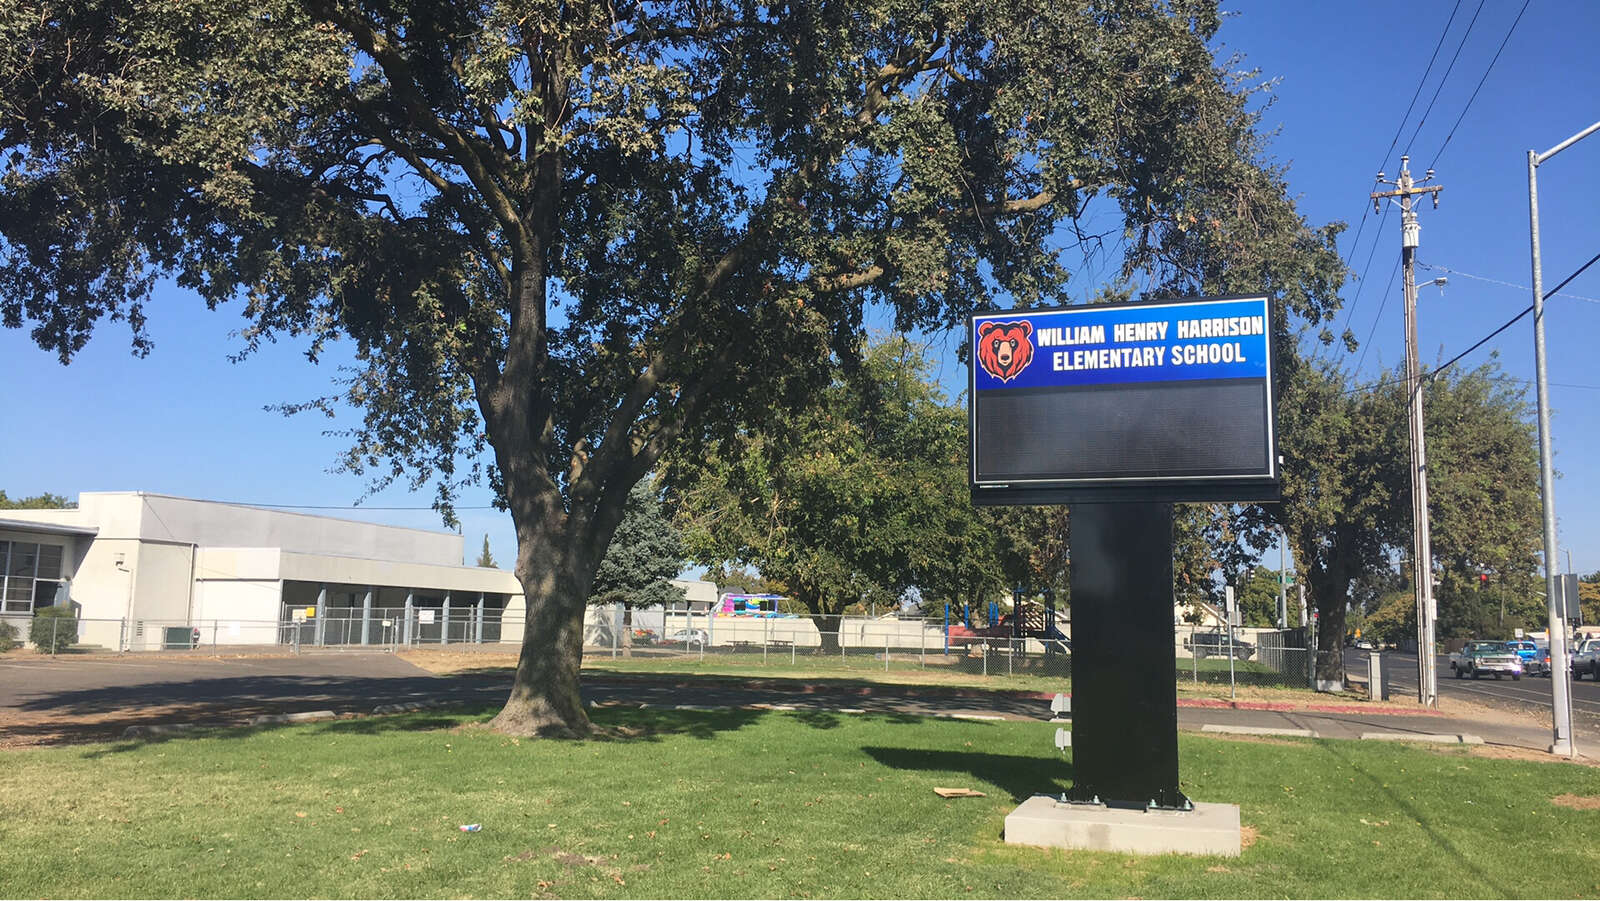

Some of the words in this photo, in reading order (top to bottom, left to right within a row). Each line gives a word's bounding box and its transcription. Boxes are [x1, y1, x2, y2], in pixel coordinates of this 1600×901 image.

[1037, 325, 1105, 347] WILLIAM
[1114, 321, 1169, 343] HENRY
[1177, 316, 1264, 339] HARRISON
[1053, 346, 1166, 371] ELEMENTARY
[1171, 342, 1246, 365] SCHOOL
